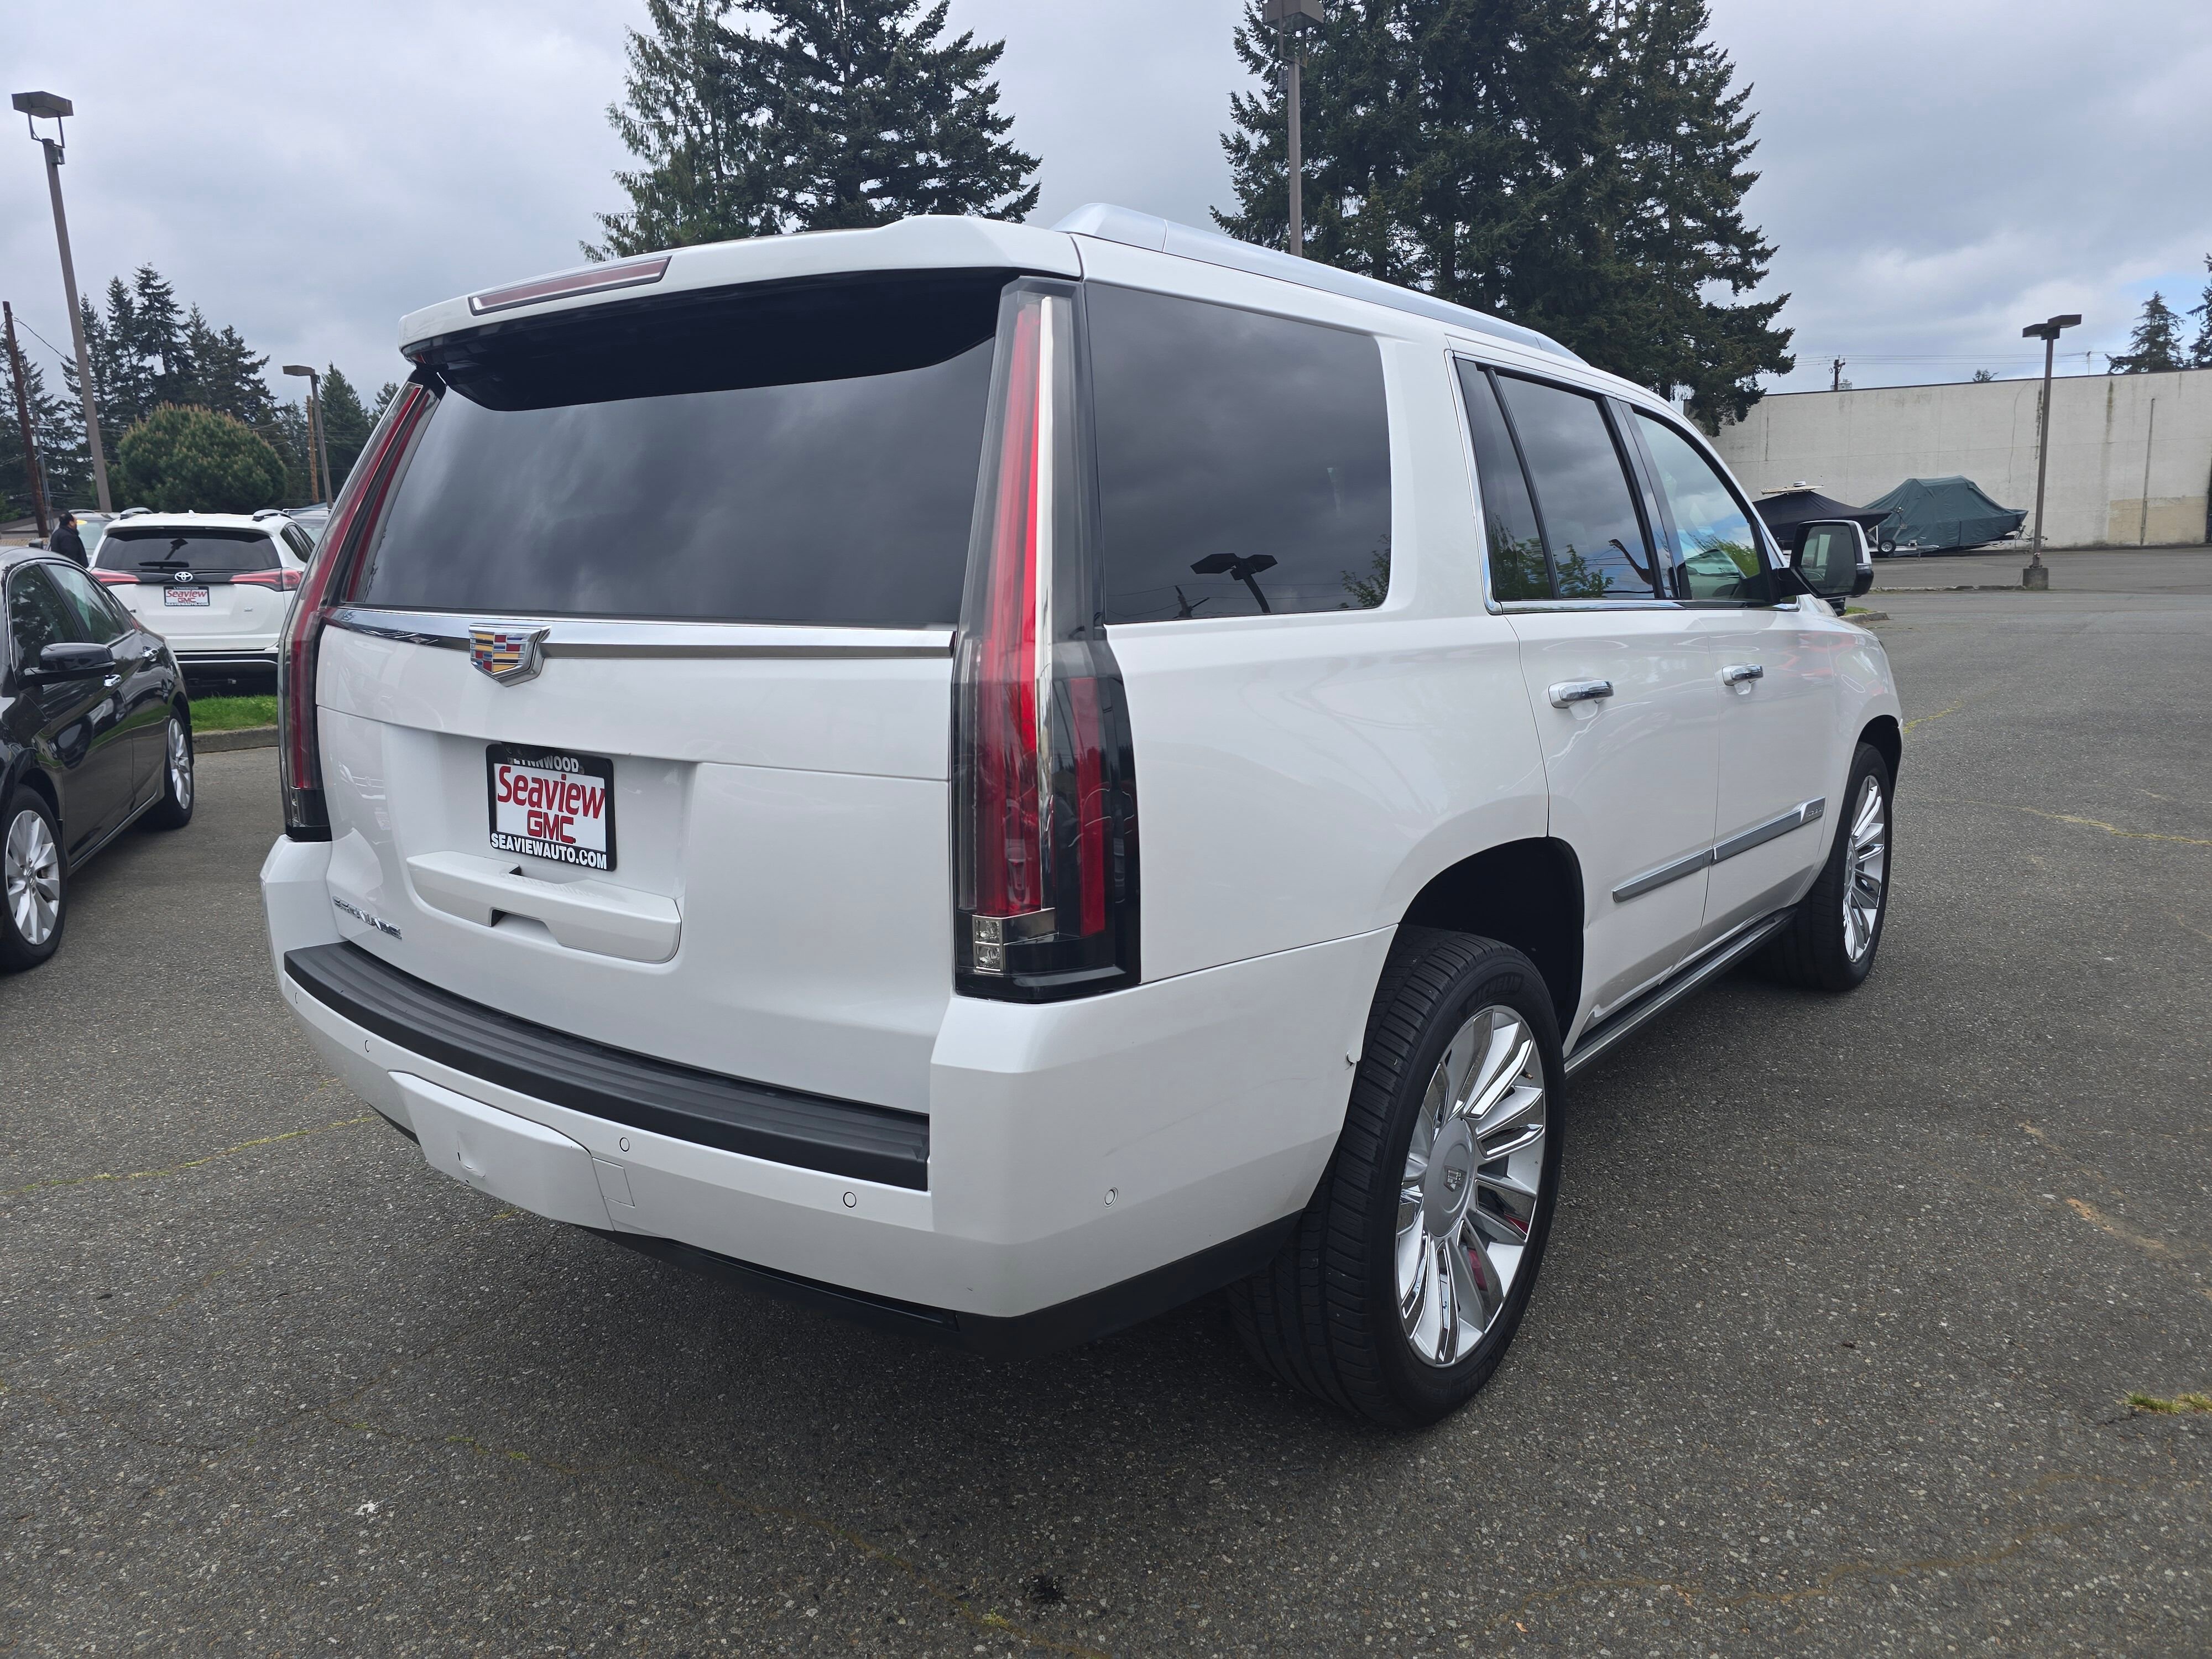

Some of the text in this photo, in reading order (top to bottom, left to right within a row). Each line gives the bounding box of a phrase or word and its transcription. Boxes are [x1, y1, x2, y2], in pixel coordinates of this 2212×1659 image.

[497, 766, 606, 819] Seaview
[527, 810, 576, 844] GMC
[491, 833, 607, 869] SEAVIEWAUTO.COM
